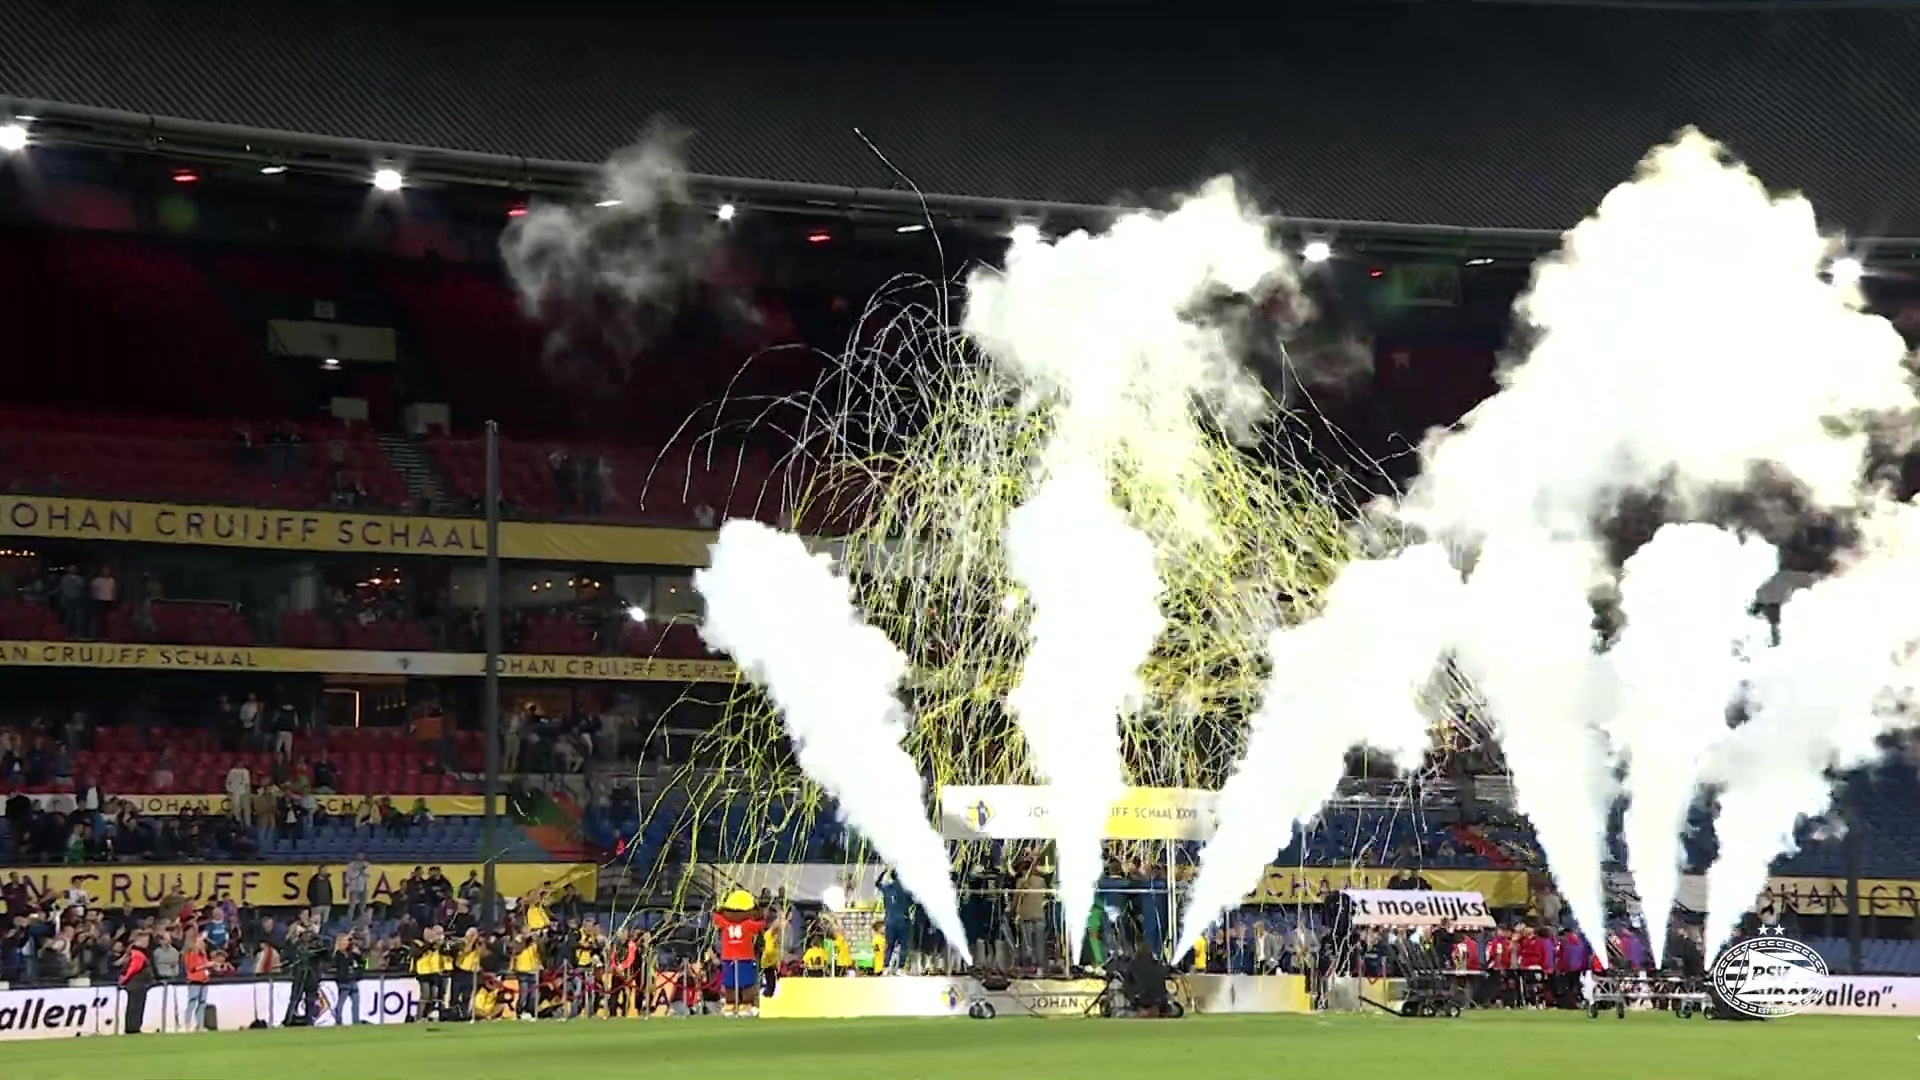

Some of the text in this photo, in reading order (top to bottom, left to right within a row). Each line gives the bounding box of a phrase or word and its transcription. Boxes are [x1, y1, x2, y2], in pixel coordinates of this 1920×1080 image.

[0, 502, 485, 550] OHAN CRUIJFF SCHAAL
[160, 650, 257, 667] SCHAAL
[368, 990, 418, 1017] JOH
[1032, 997, 1078, 1009] JOHAN
